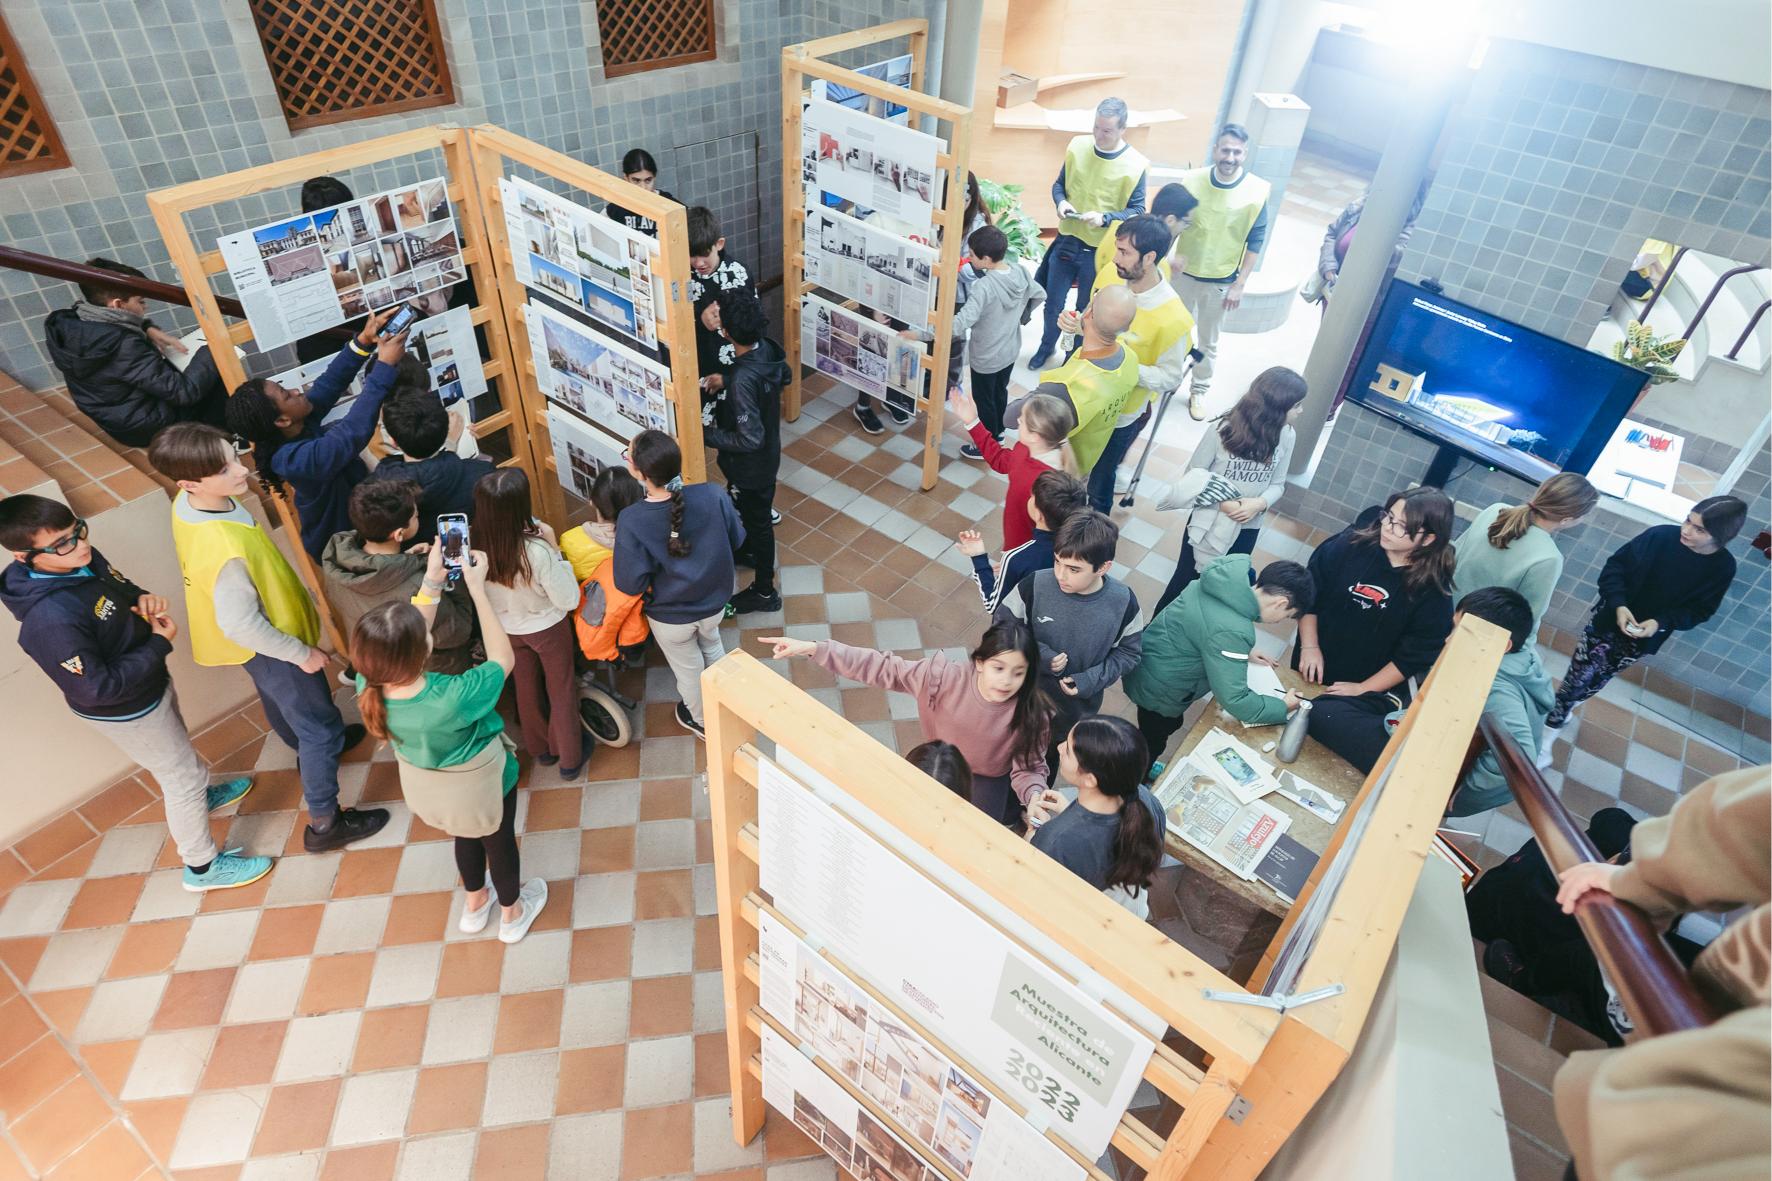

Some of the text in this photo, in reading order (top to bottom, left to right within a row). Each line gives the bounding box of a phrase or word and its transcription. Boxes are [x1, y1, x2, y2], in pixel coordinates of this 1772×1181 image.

[1233, 461, 1261, 472] WILL
[1009, 989, 1111, 1067] Arquitectura
[1021, 983, 1088, 1037] Muestra
[1008, 1048, 1081, 1112] 2022
[1037, 1035, 1102, 1086] Alicante
[1005, 1061, 1075, 1123] 2023
